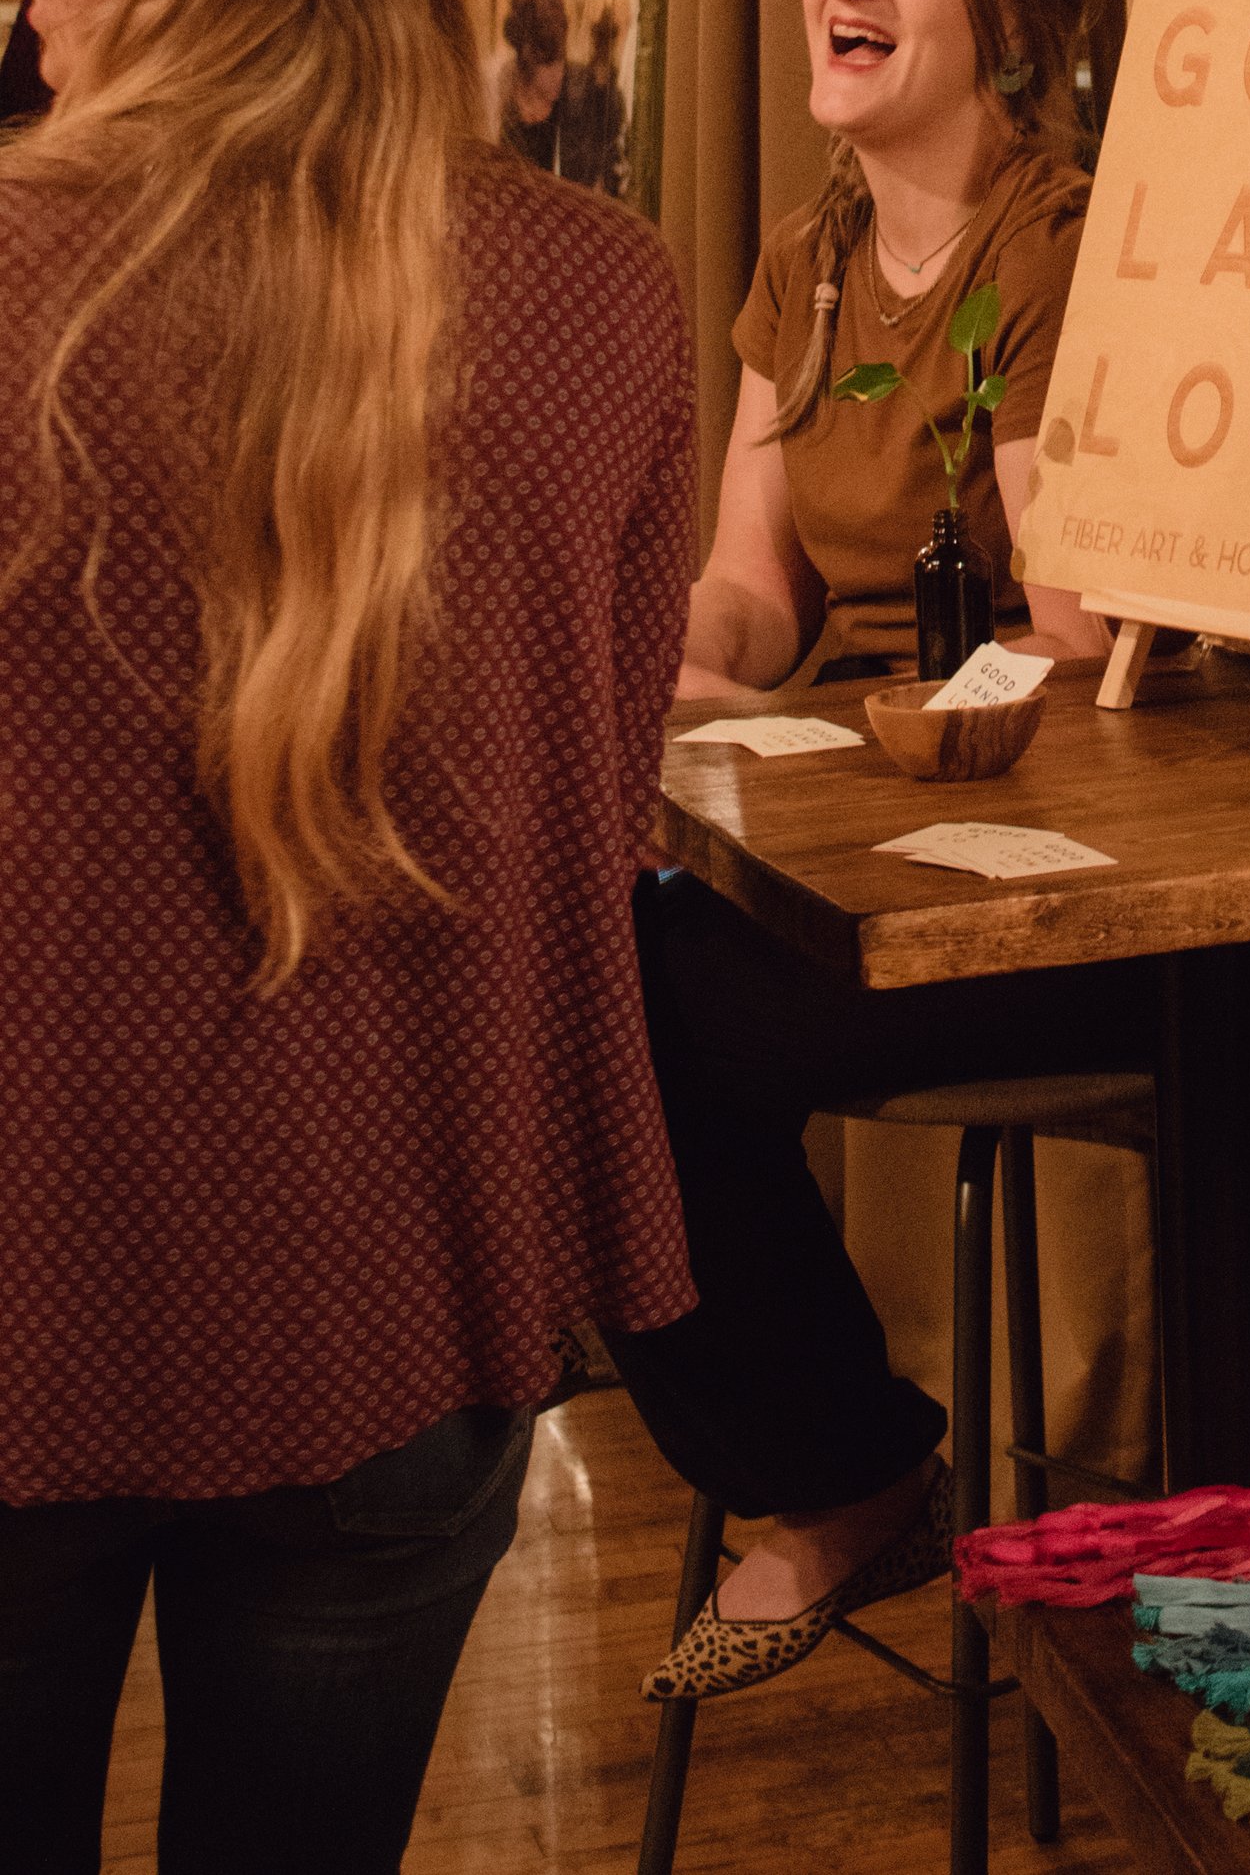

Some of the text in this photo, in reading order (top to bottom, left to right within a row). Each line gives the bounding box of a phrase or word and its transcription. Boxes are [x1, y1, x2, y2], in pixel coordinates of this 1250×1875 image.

[1060, 516, 1124, 555] FIBER
[1130, 528, 1183, 563] ART
[1189, 535, 1208, 569] &
[980, 662, 1016, 692] GOOD
